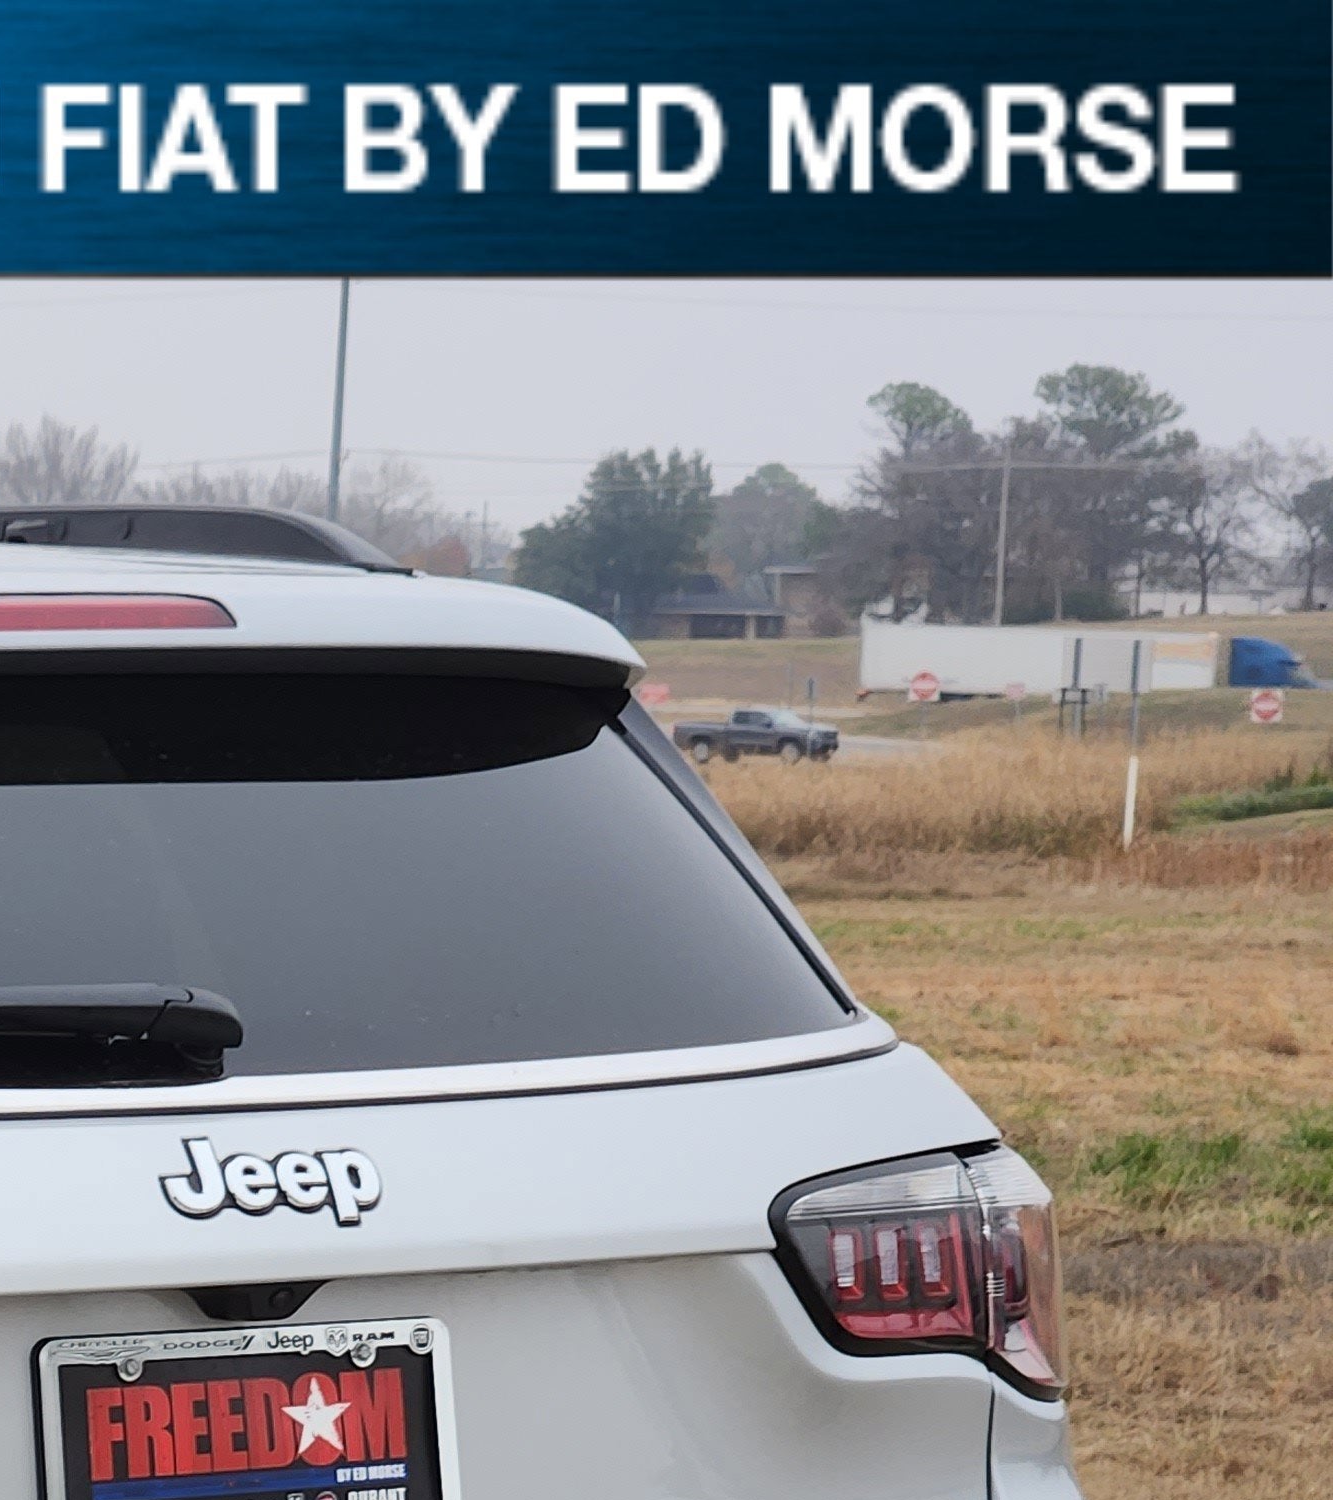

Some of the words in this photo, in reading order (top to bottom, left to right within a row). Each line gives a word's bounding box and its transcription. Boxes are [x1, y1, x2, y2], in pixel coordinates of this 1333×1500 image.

[159, 1137, 382, 1226] Jeep
[163, 1338, 242, 1350] DODGE
[267, 1331, 314, 1350] Jeep
[352, 1331, 396, 1343] RAM
[86, 1367, 408, 1482] FREEDOM
